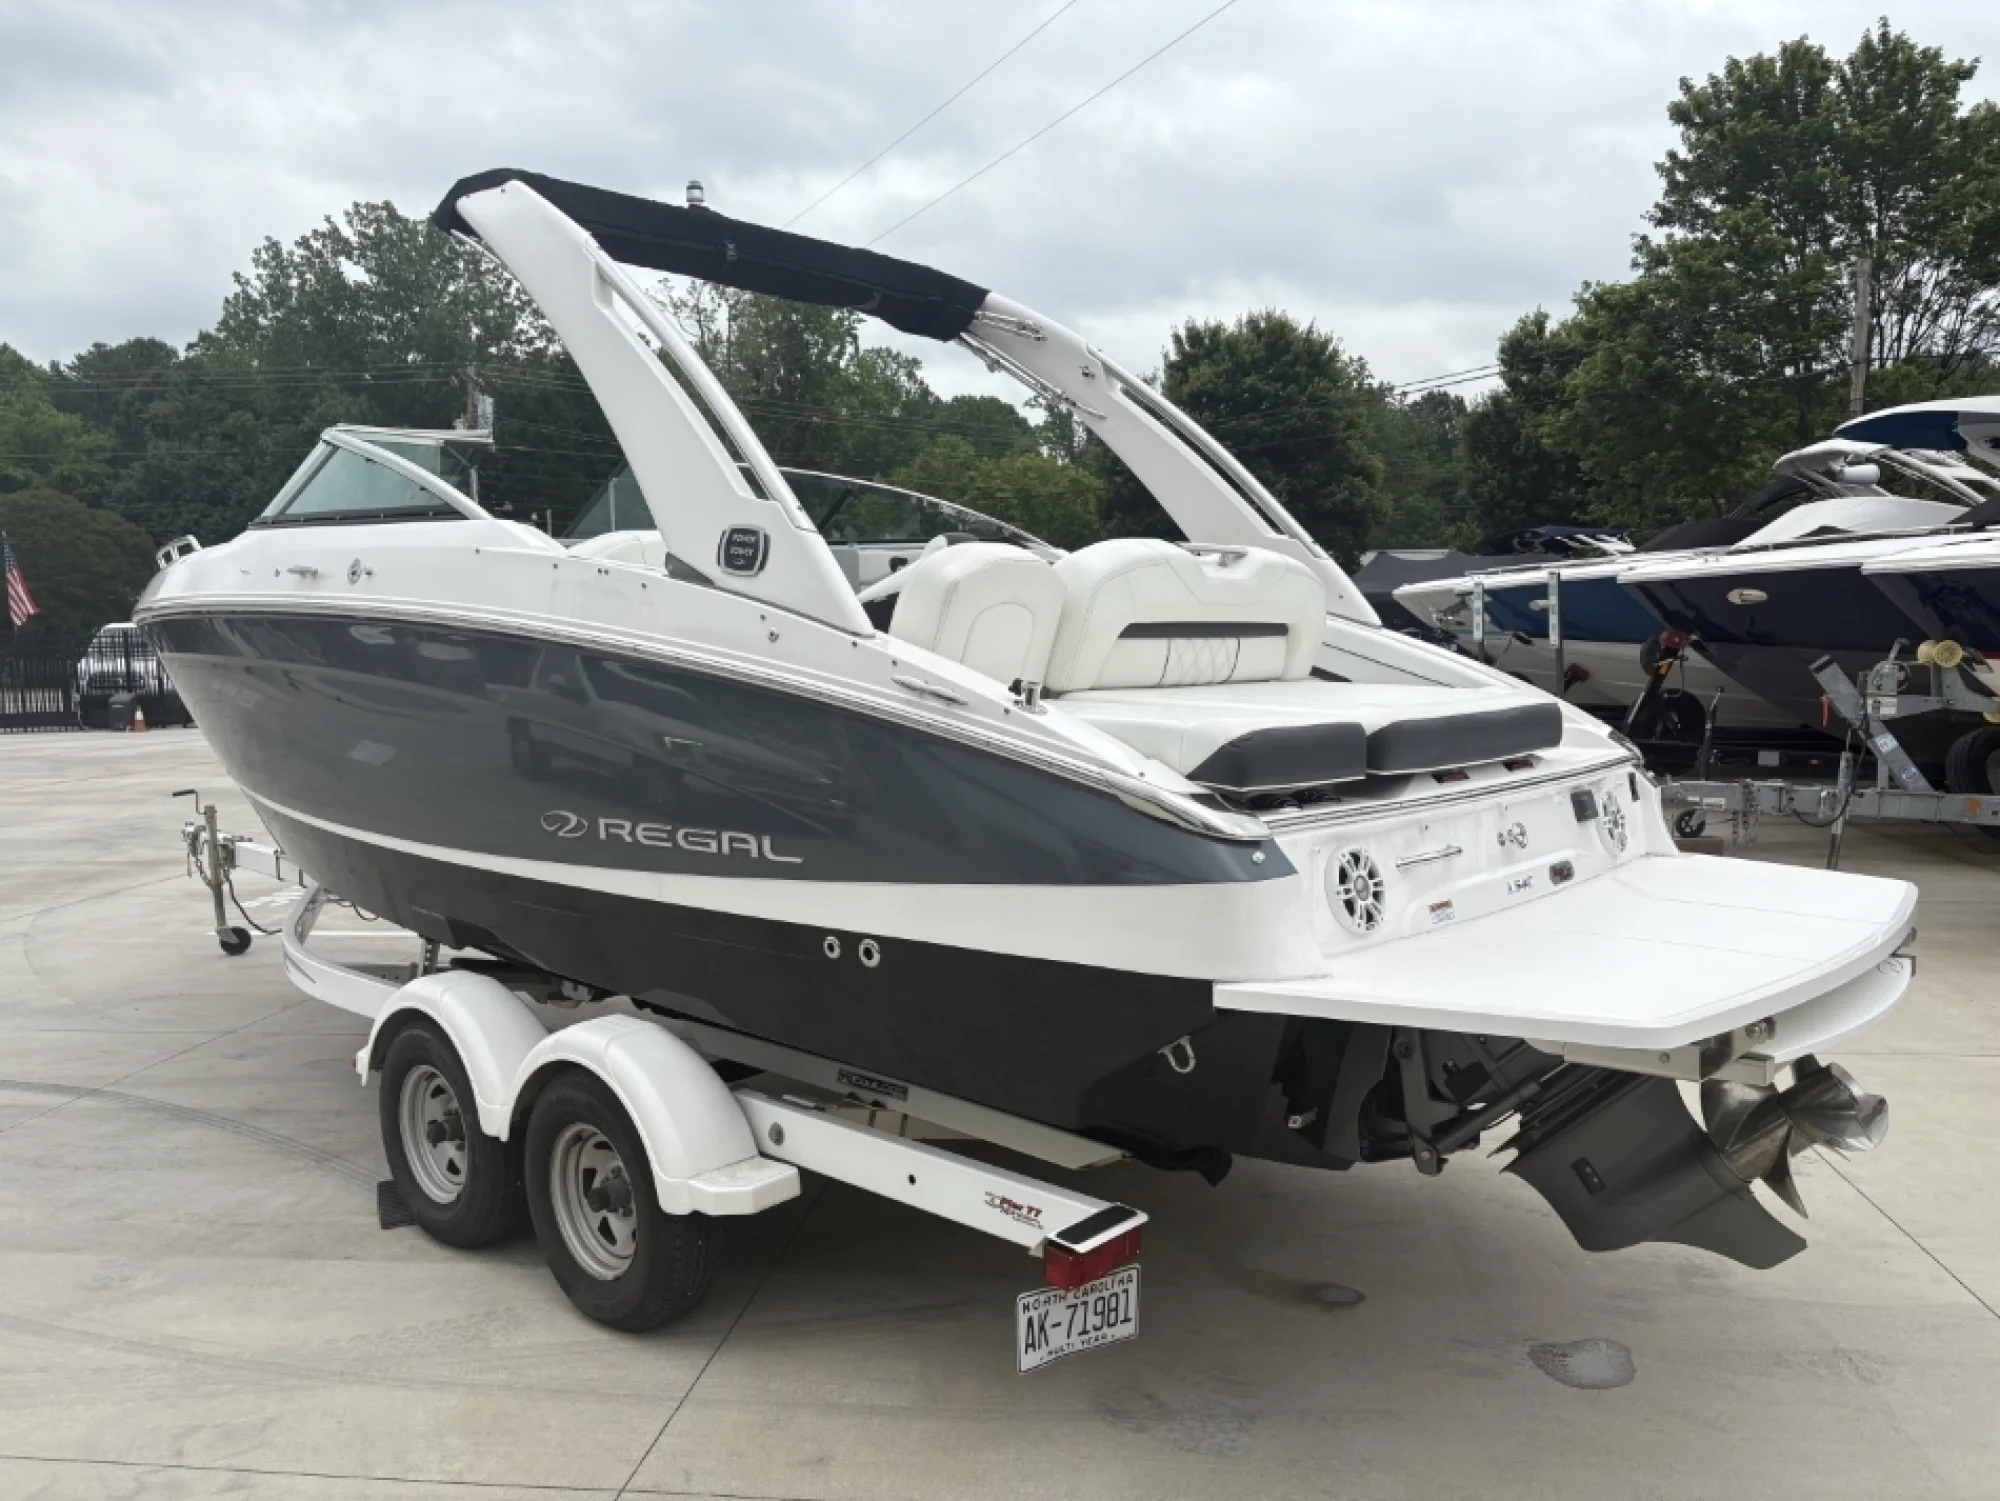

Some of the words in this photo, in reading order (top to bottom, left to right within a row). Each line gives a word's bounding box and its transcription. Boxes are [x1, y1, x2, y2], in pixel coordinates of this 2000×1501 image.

[598, 817, 804, 864] REGAL
[1022, 1292, 1067, 1314] NORTH
[1074, 1273, 1134, 1299] CAROLINA
[1025, 1288, 1132, 1354] AK-71981
